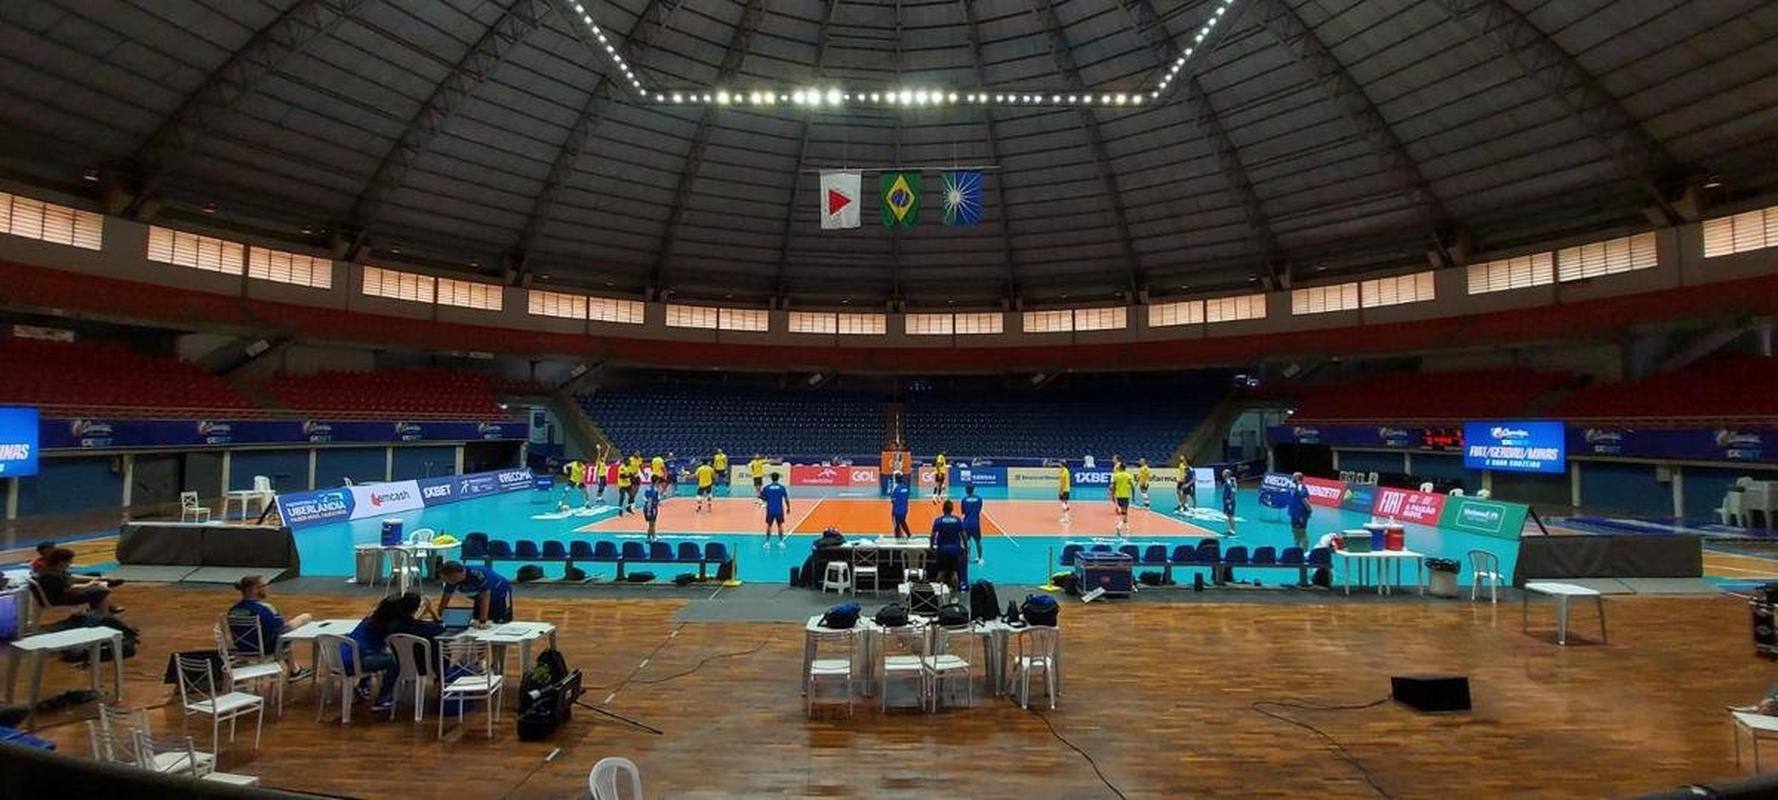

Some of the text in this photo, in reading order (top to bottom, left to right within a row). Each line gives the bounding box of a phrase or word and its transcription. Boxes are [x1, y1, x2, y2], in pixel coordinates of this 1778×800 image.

[852, 470, 877, 482] GOL
[1074, 471, 1115, 484] 1XBET
[1378, 491, 1407, 515] FIAT
